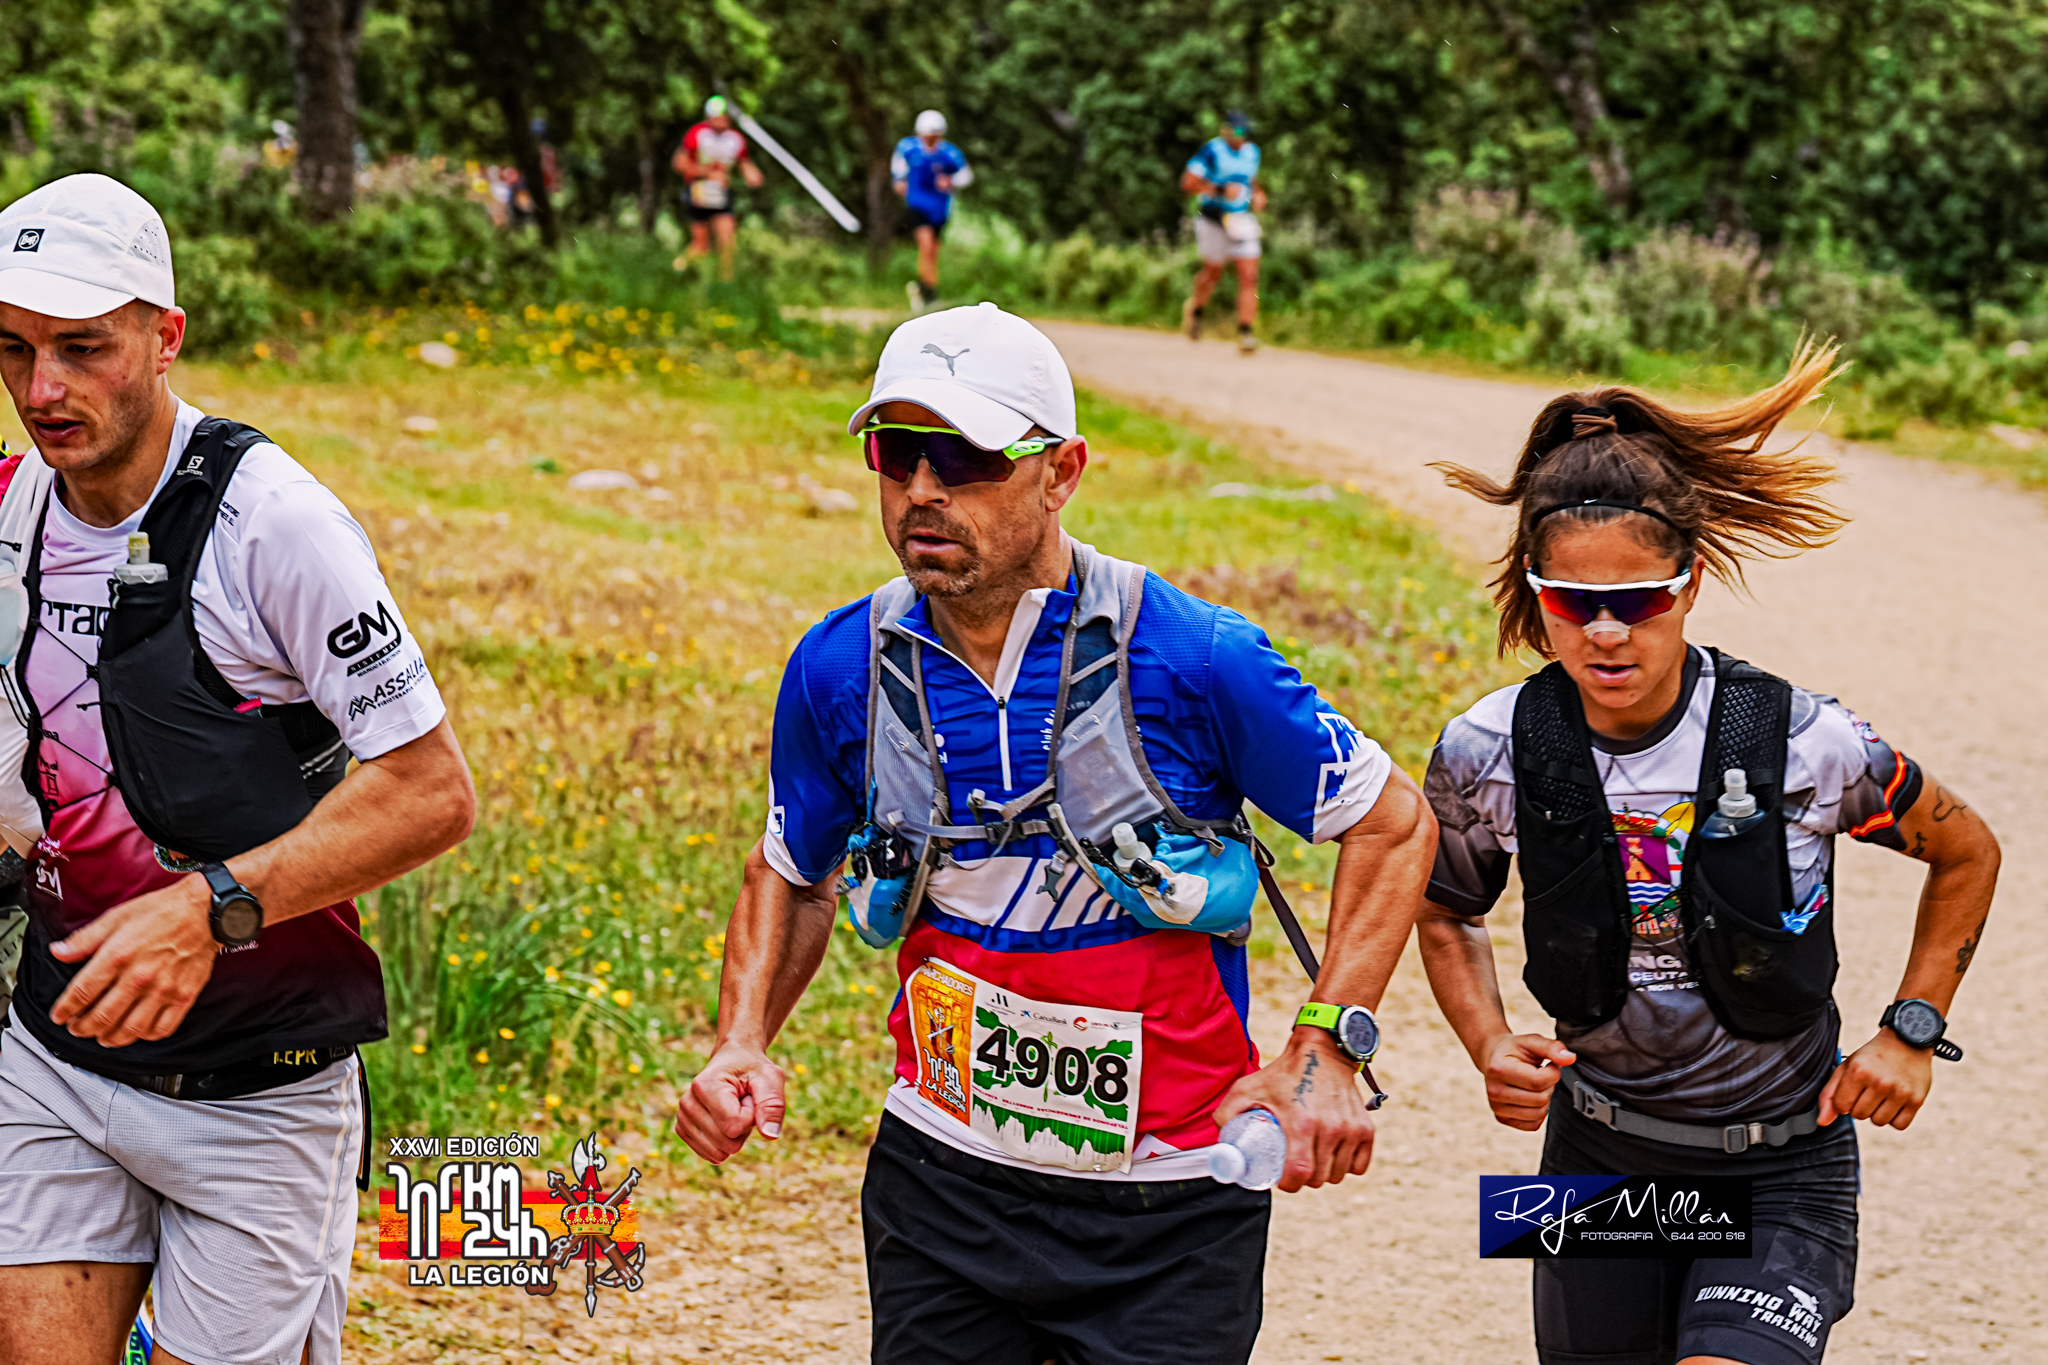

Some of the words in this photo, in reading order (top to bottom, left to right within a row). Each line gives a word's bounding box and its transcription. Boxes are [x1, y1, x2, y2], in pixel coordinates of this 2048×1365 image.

[374, 656, 425, 703] ASSALIA
[975, 1026, 1129, 1104] 4908
[1694, 1285, 1784, 1312] RUNNING
[1787, 1302, 1822, 1333] WAY
[1750, 1307, 1819, 1348] TRAINING
